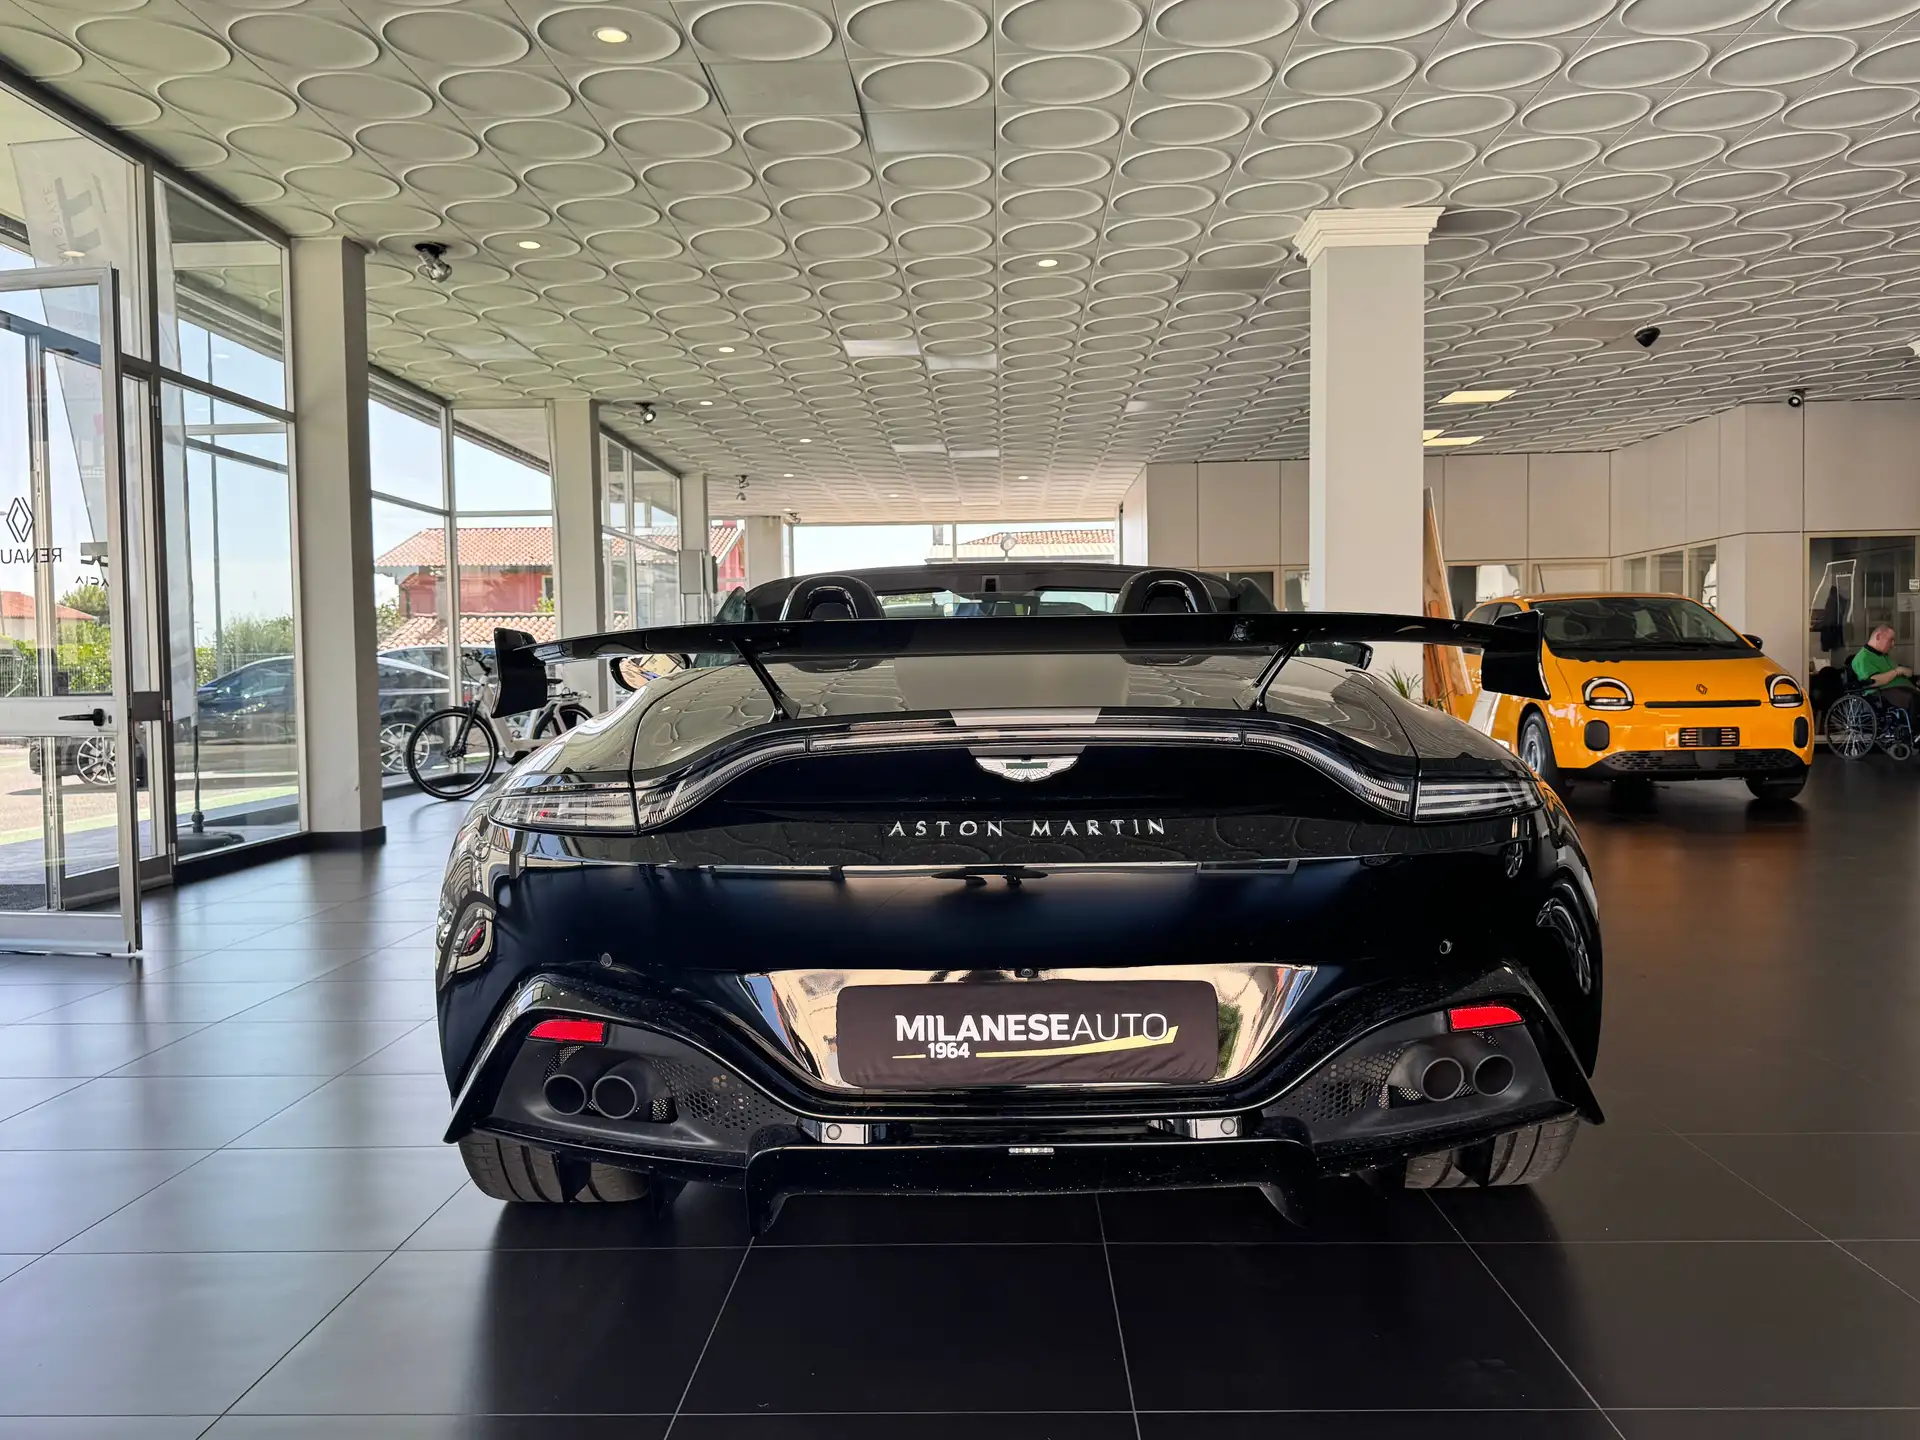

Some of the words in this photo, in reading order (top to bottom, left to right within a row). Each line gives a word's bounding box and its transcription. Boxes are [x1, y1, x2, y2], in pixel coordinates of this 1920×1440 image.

[888, 820, 1004, 837] ASTON
[1031, 818, 1165, 837] MARTIN
[927, 1042, 970, 1059] 1964
